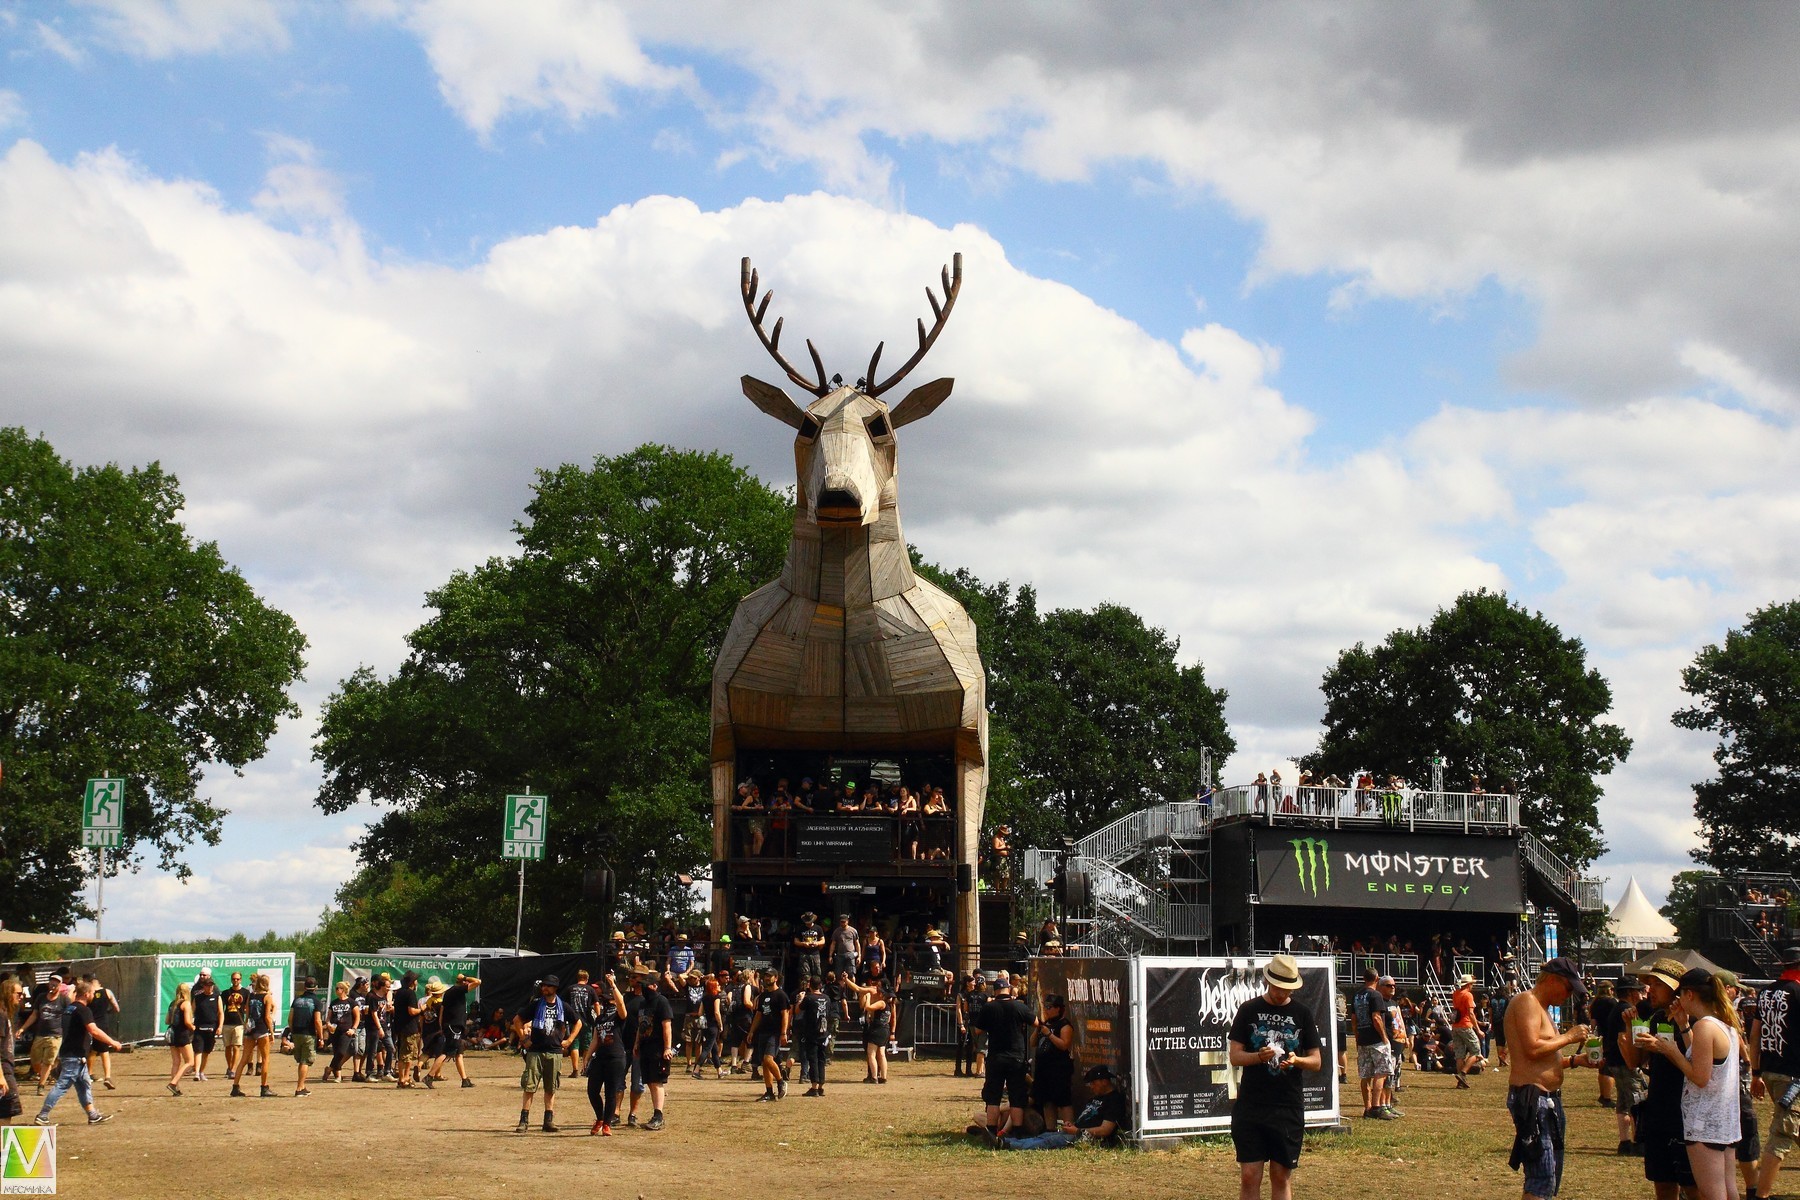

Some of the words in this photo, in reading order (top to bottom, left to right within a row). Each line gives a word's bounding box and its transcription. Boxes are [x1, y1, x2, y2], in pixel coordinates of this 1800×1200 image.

[82, 829, 121, 846] EXIT
[503, 842, 544, 858] EXIT
[1367, 882, 1470, 895] ENERGY
[163, 960, 219, 968] NOTAUSGANG
[225, 958, 272, 967] EMERGENCY
[273, 958, 290, 966] EXIT
[336, 957, 396, 968] NOTAUSGANG
[402, 960, 456, 970] EMERGENCY
[457, 962, 476, 970] EXIT
[1066, 977, 1089, 1002] BEYOND
[1089, 978, 1102, 1005] THE
[1102, 978, 1120, 1006] BLACK
[1771, 989, 1790, 1002] ARE
[1776, 1000, 1788, 1011] TO
[1148, 1037, 1165, 1050] AT
[1164, 1036, 1187, 1050] THE
[1188, 1035, 1222, 1049] GATES
